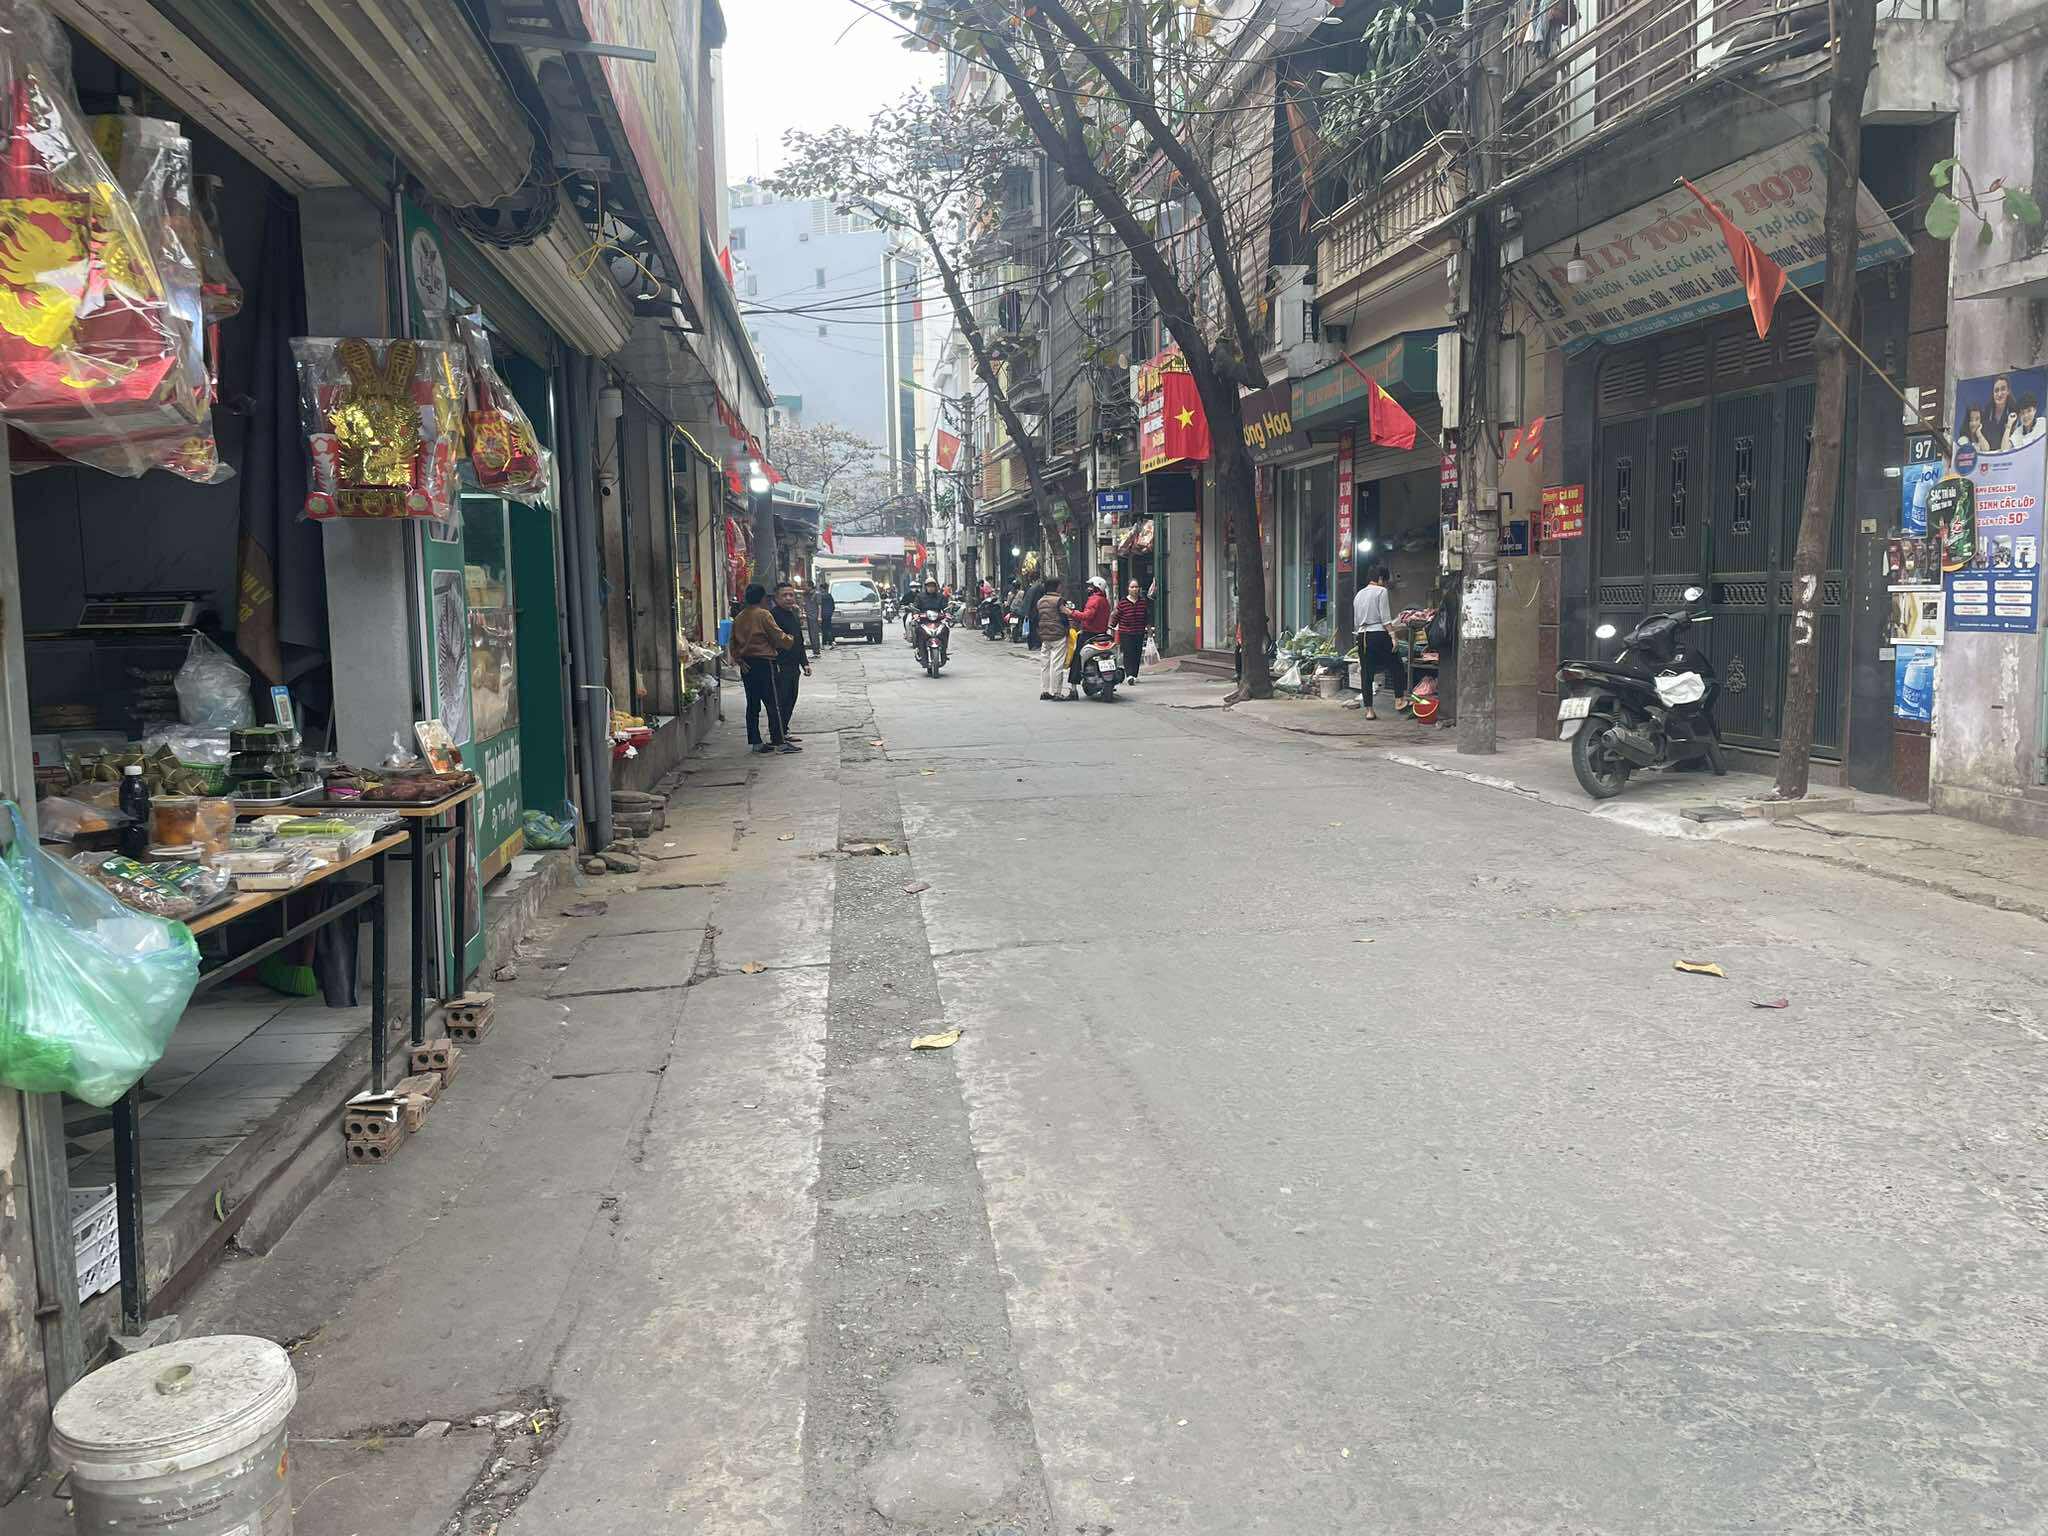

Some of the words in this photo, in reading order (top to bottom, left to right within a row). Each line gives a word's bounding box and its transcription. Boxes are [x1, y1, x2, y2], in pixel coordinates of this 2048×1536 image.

[1732, 164, 1813, 215] HỢP
[1262, 411, 1292, 439] Hoa
[1915, 440, 1932, 459] 97
[1979, 501, 1998, 510] SINH
